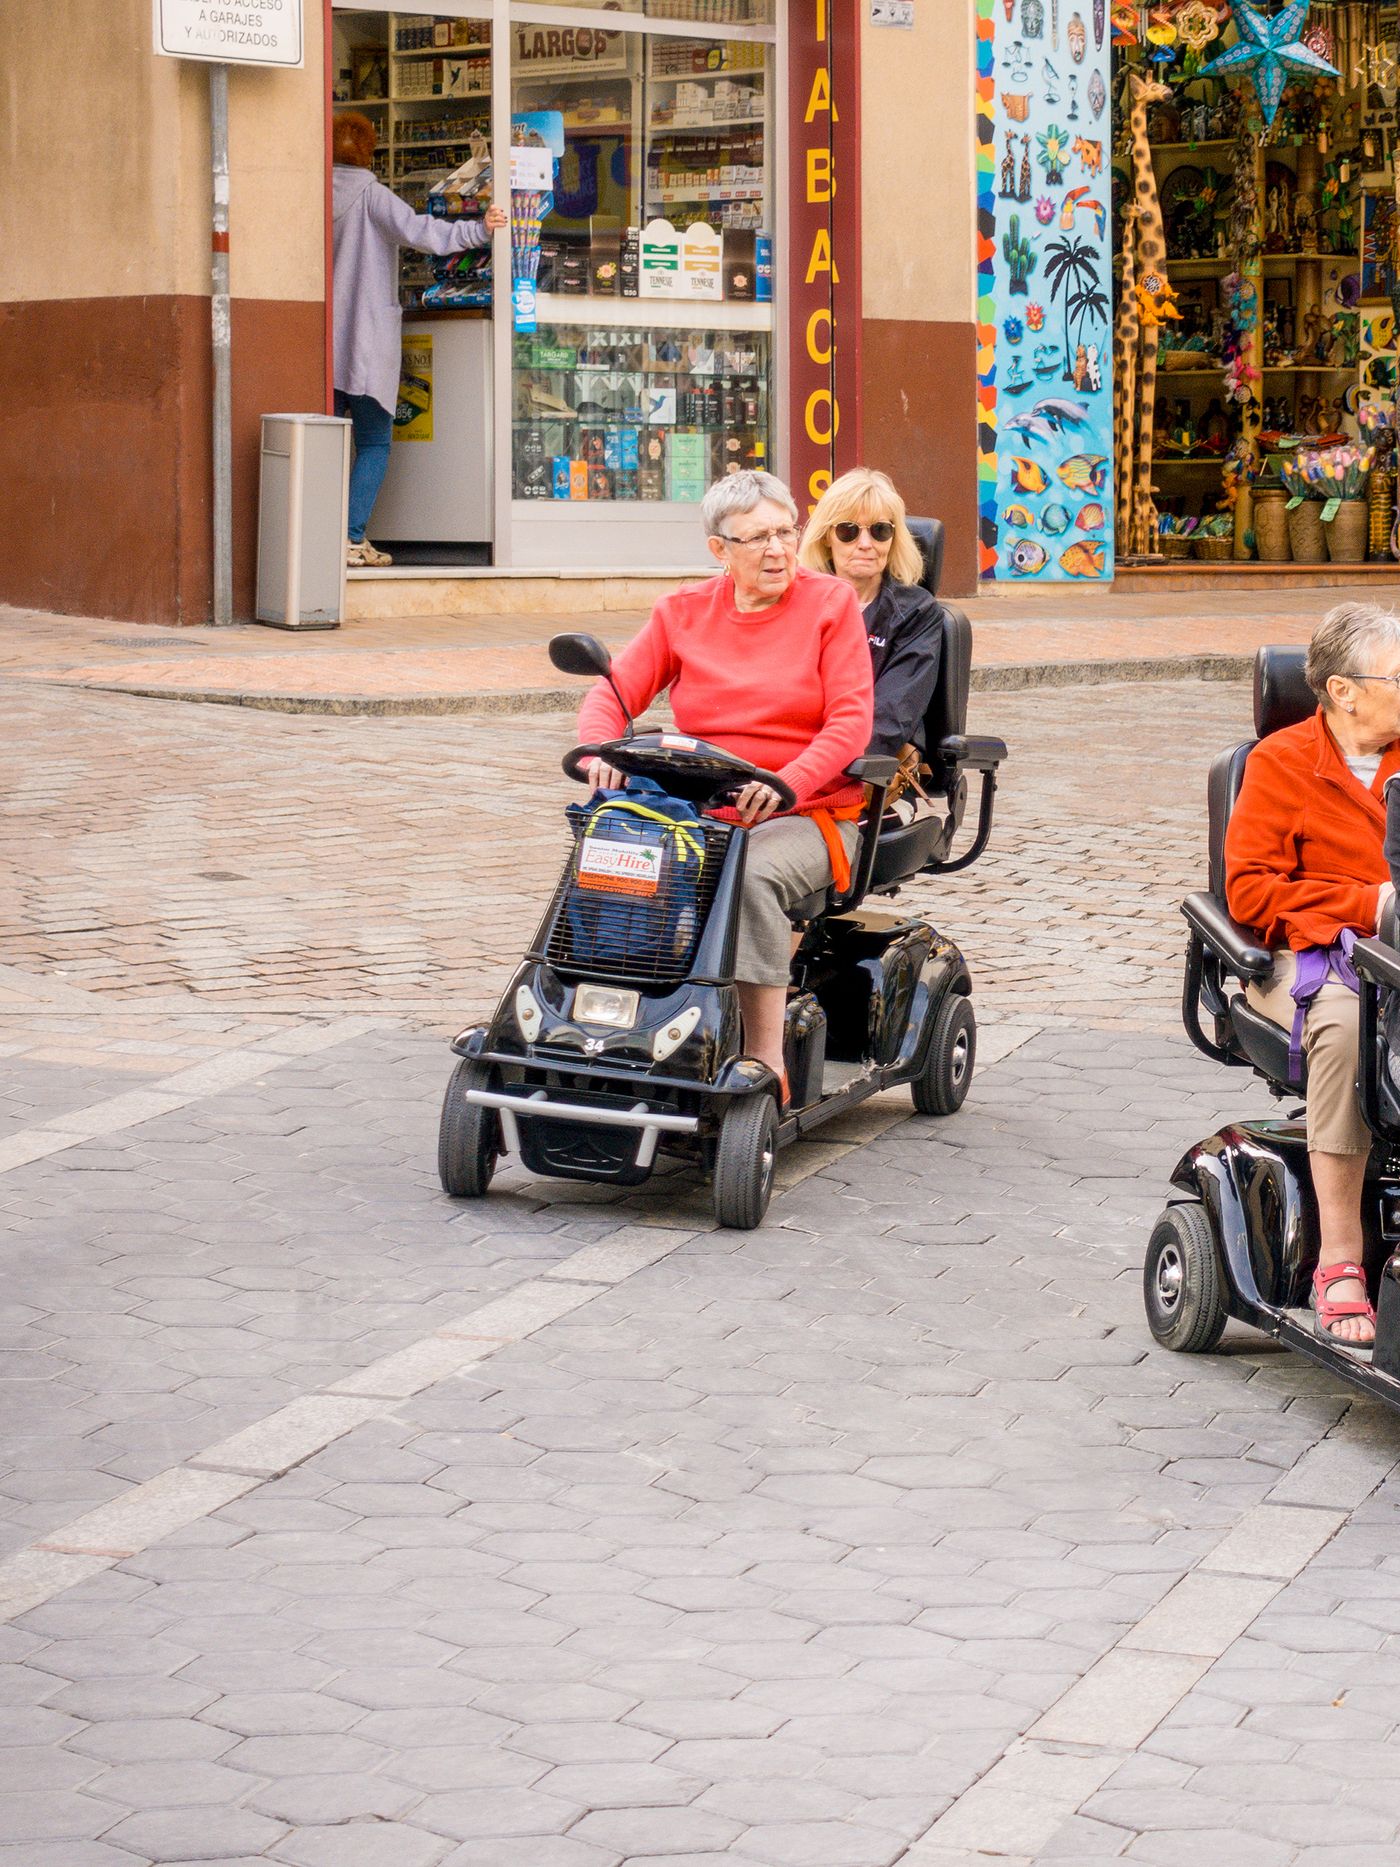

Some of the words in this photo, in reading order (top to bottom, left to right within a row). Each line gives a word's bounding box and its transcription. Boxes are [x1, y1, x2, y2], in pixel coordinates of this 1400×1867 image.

[199, 9, 207, 21] A
[209, 10, 263, 28] GARAJES
[184, 26, 192, 39] Y
[584, 1038, 605, 1053] 34
